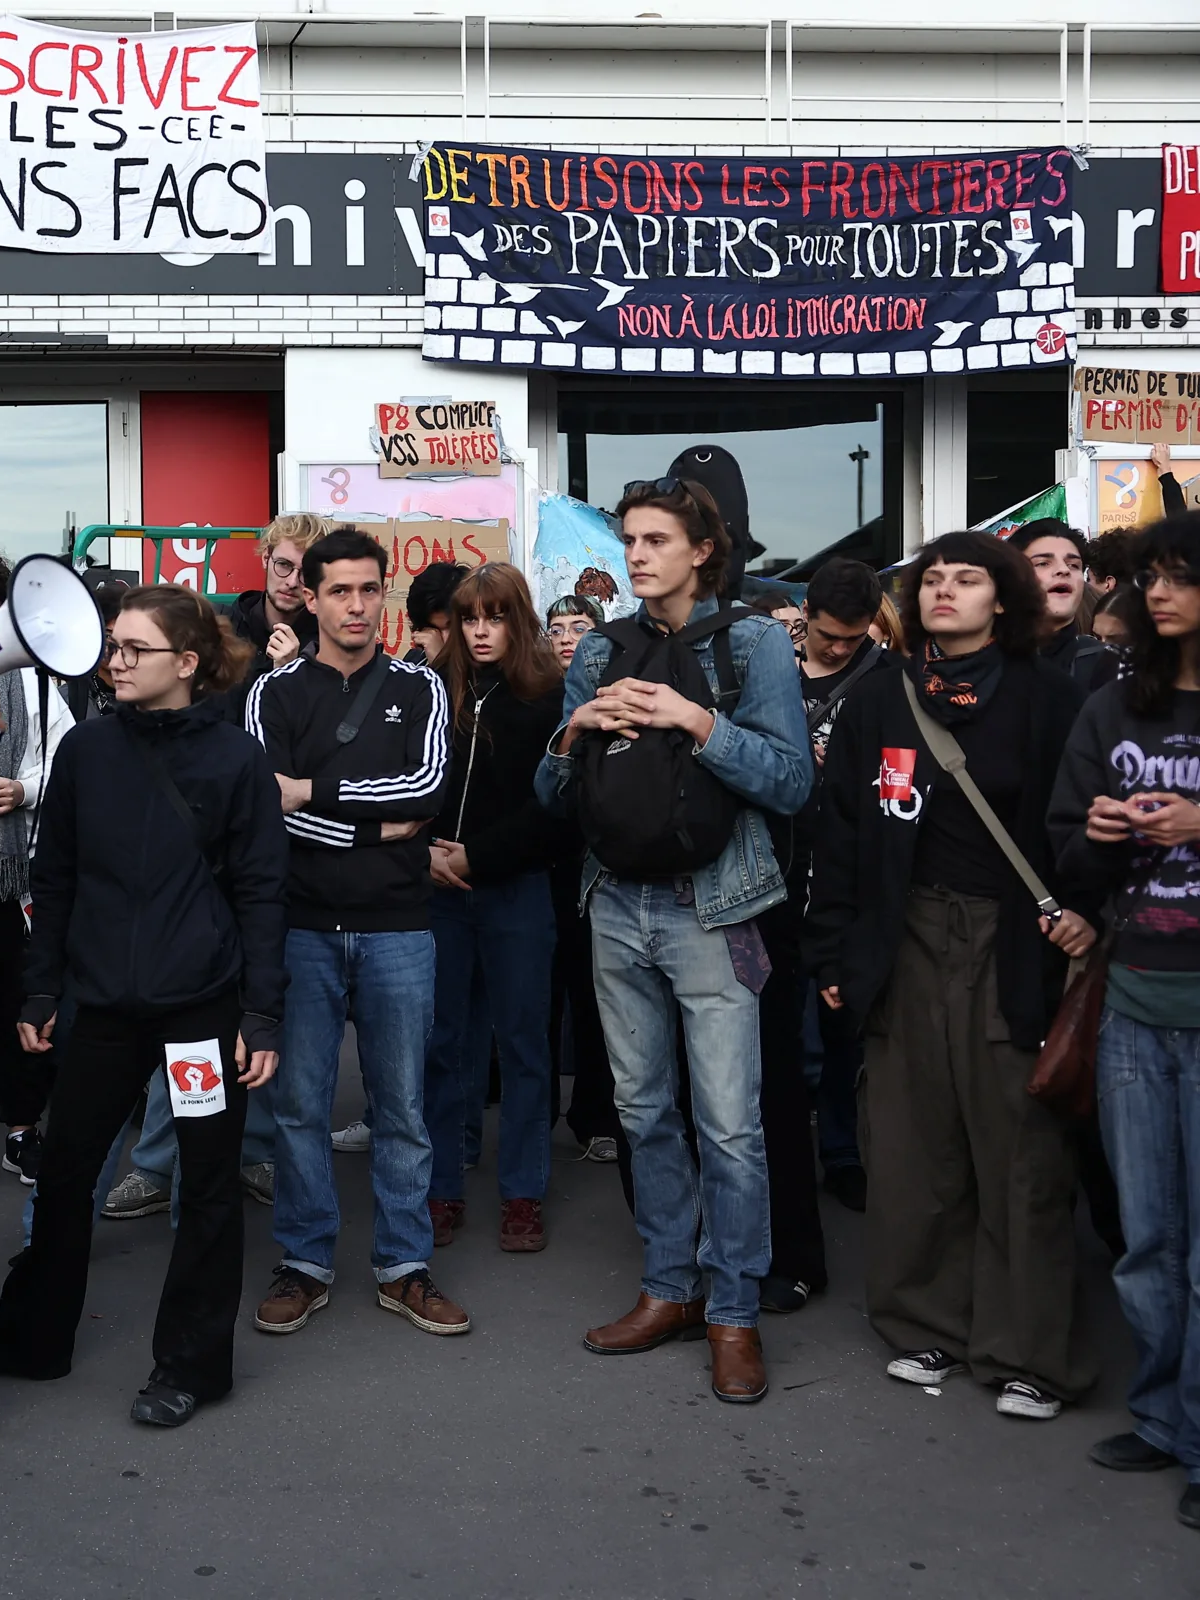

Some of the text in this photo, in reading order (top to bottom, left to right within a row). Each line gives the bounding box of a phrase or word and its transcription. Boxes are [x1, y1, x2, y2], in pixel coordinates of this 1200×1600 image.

[114, 158, 268, 241] FACS
[720, 163, 791, 208] LES
[492, 223, 552, 255] DES
[561, 211, 781, 282] PAPIERS
[784, 235, 848, 267] POUR
[617, 303, 675, 338] NON
[1147, 371, 1168, 397] DE
[379, 403, 410, 435] P8
[379, 433, 420, 466] VSS
